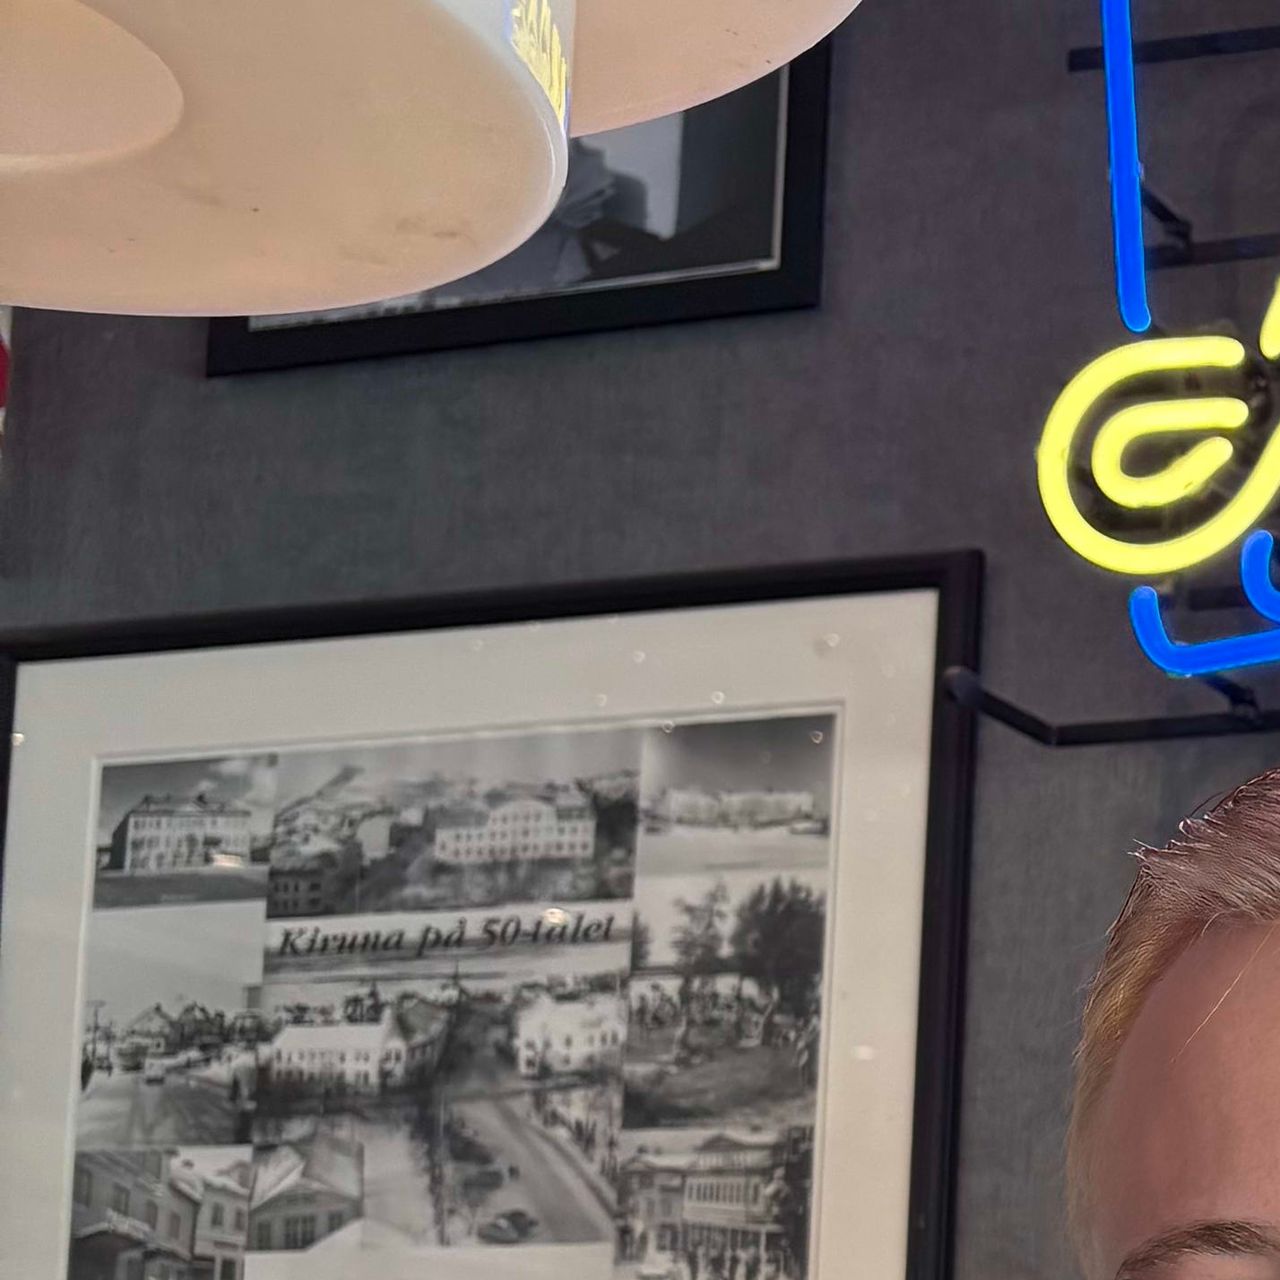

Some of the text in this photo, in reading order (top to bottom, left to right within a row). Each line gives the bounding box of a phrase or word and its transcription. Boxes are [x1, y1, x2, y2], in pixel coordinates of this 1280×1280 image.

[278, 911, 615, 957] Kiruna på 50-talet
